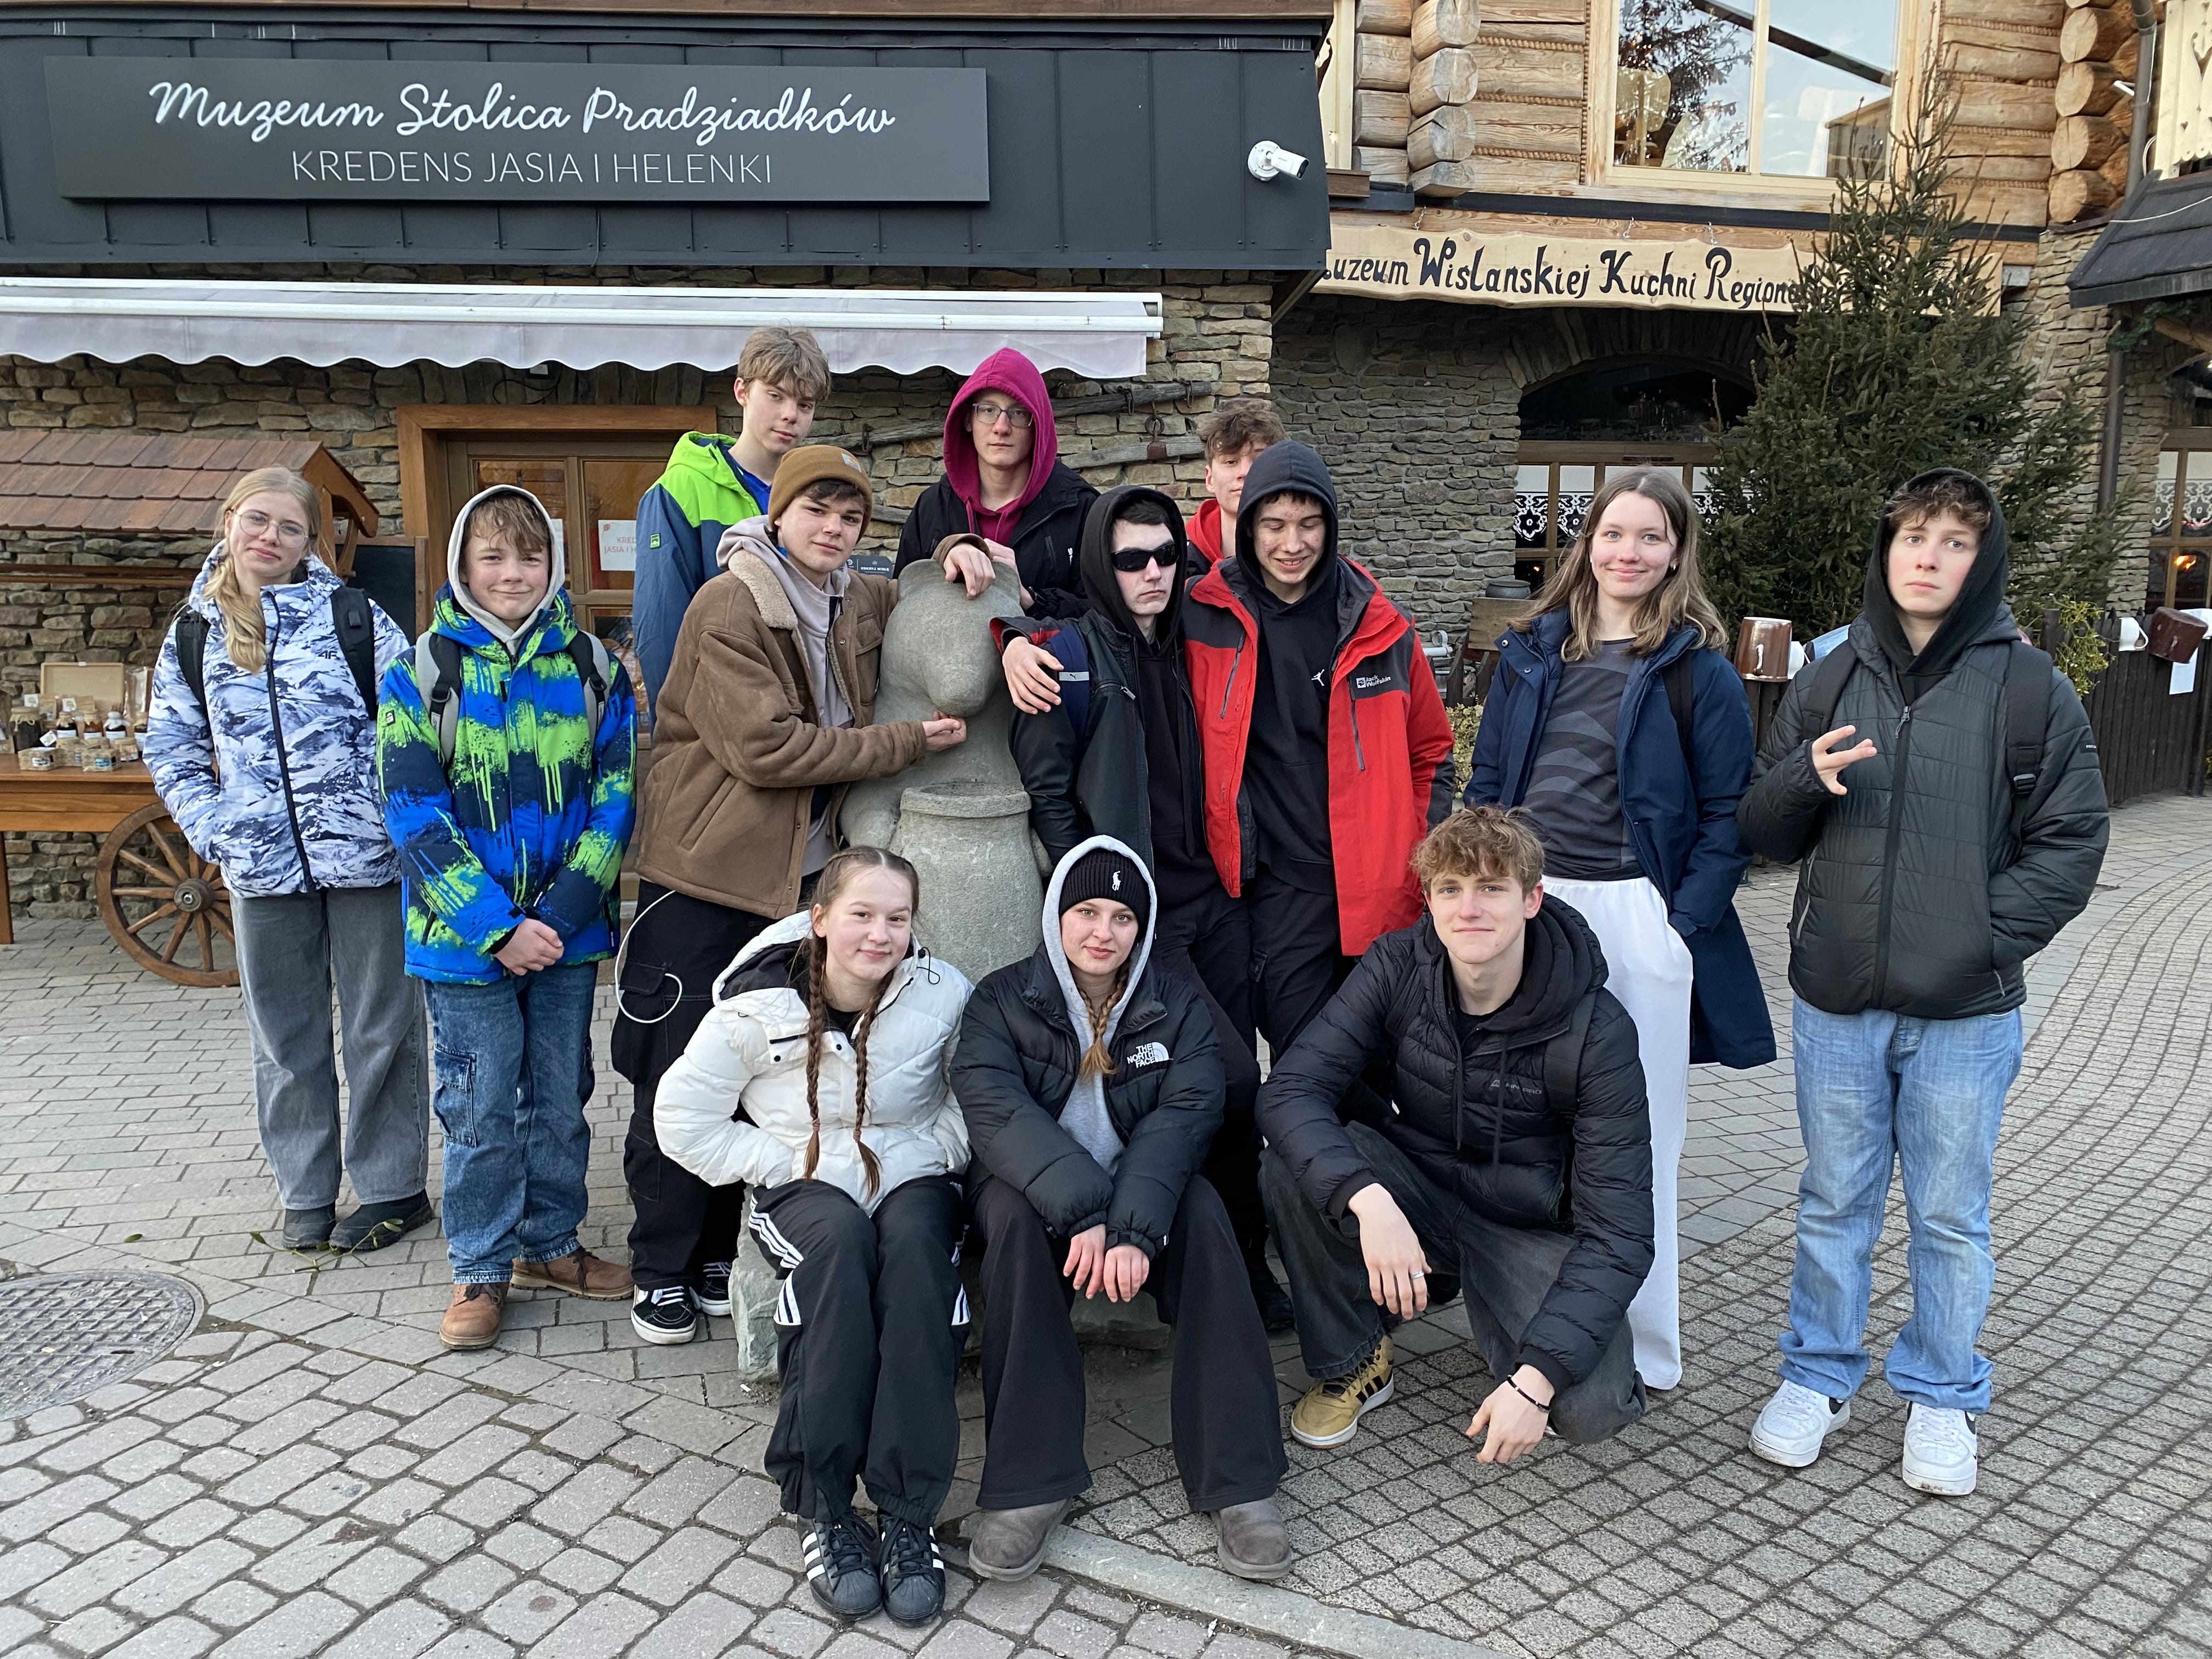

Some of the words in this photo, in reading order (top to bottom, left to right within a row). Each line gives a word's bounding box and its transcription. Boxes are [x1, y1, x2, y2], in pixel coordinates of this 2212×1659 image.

[149, 82, 383, 142] Muzeum
[396, 82, 571, 136] Stolica
[583, 86, 896, 146] Pradziadków
[292, 150, 472, 183] KREDENS
[483, 153, 583, 183] JASIA
[594, 153, 599, 183] I
[613, 154, 771, 184] HELENKI
[1599, 250, 1696, 300] Kuchni
[1366, 676, 1391, 687] Wolfskin
[1136, 1043, 1153, 1054] THE
[1127, 1049, 1155, 1064] NORTH
[1135, 1057, 1155, 1069] FACE
